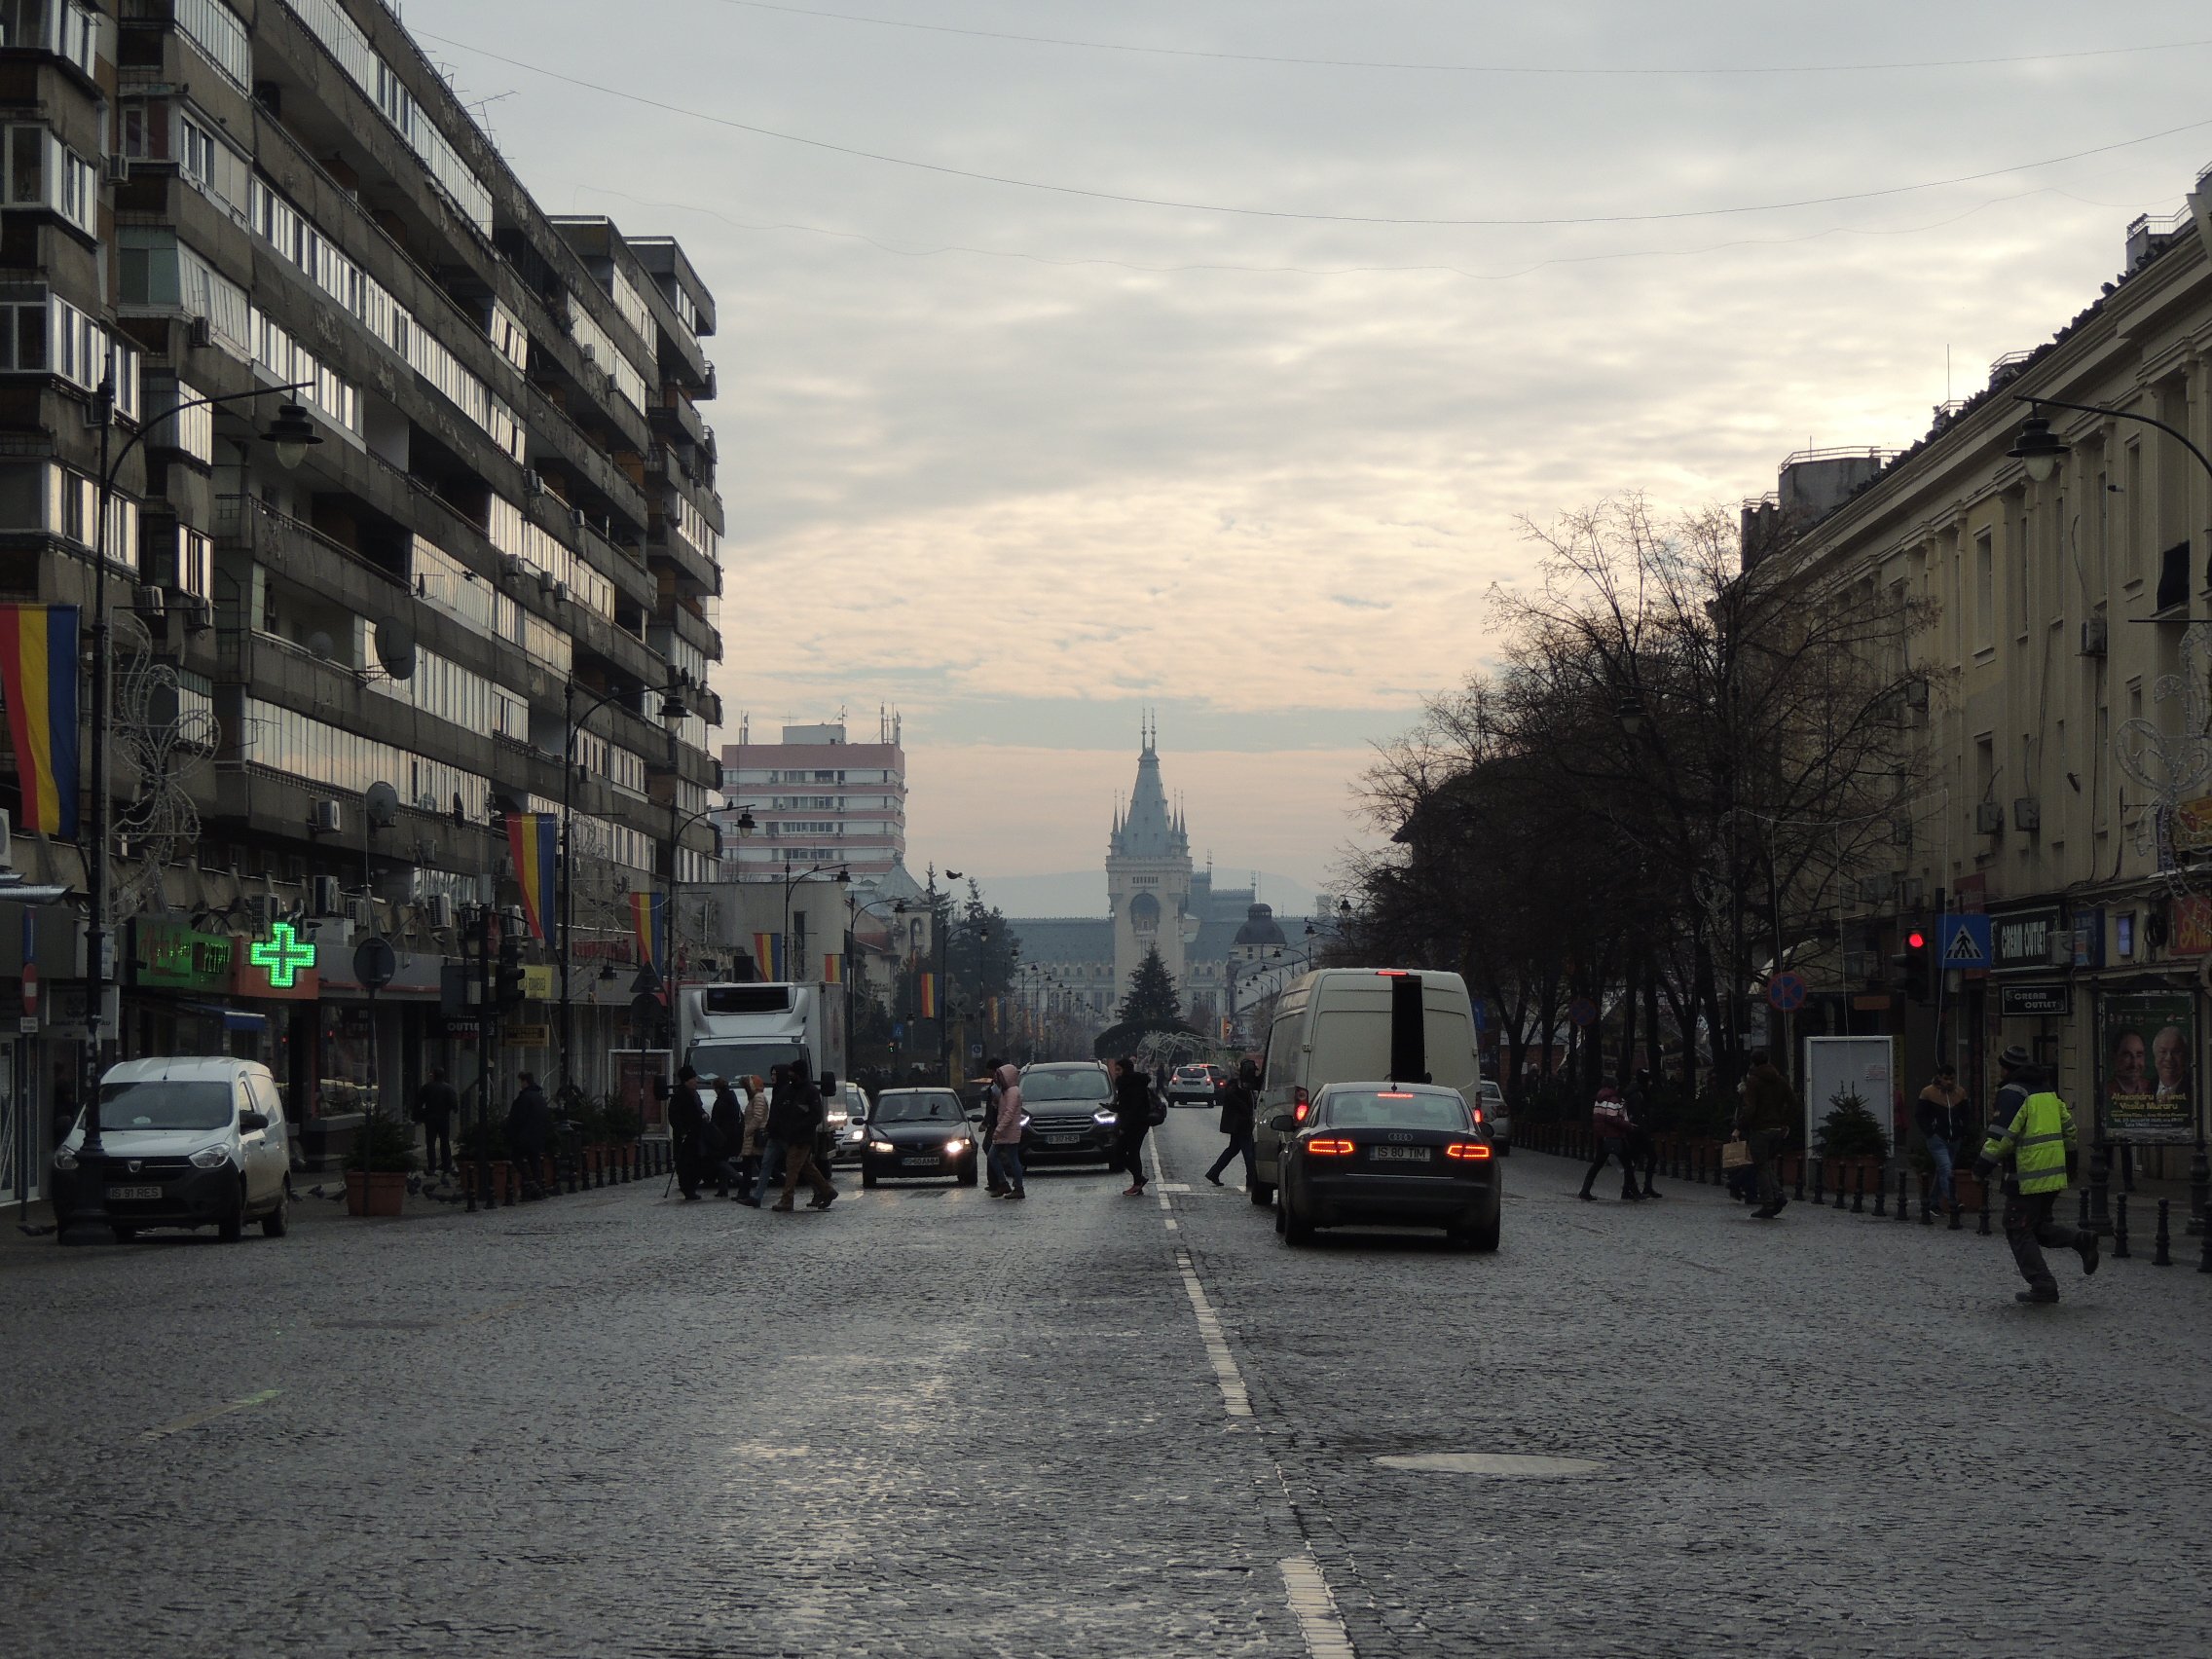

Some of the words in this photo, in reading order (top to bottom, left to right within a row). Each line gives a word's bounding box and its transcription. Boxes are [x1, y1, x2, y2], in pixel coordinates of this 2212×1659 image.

[2014, 992, 2046, 1001] CREAM
[2025, 1001, 2057, 1010] OUTLET
[1378, 1147, 1387, 1157] IS
[1391, 1148, 1404, 1157] 80
[1409, 1148, 1425, 1158] TIM
